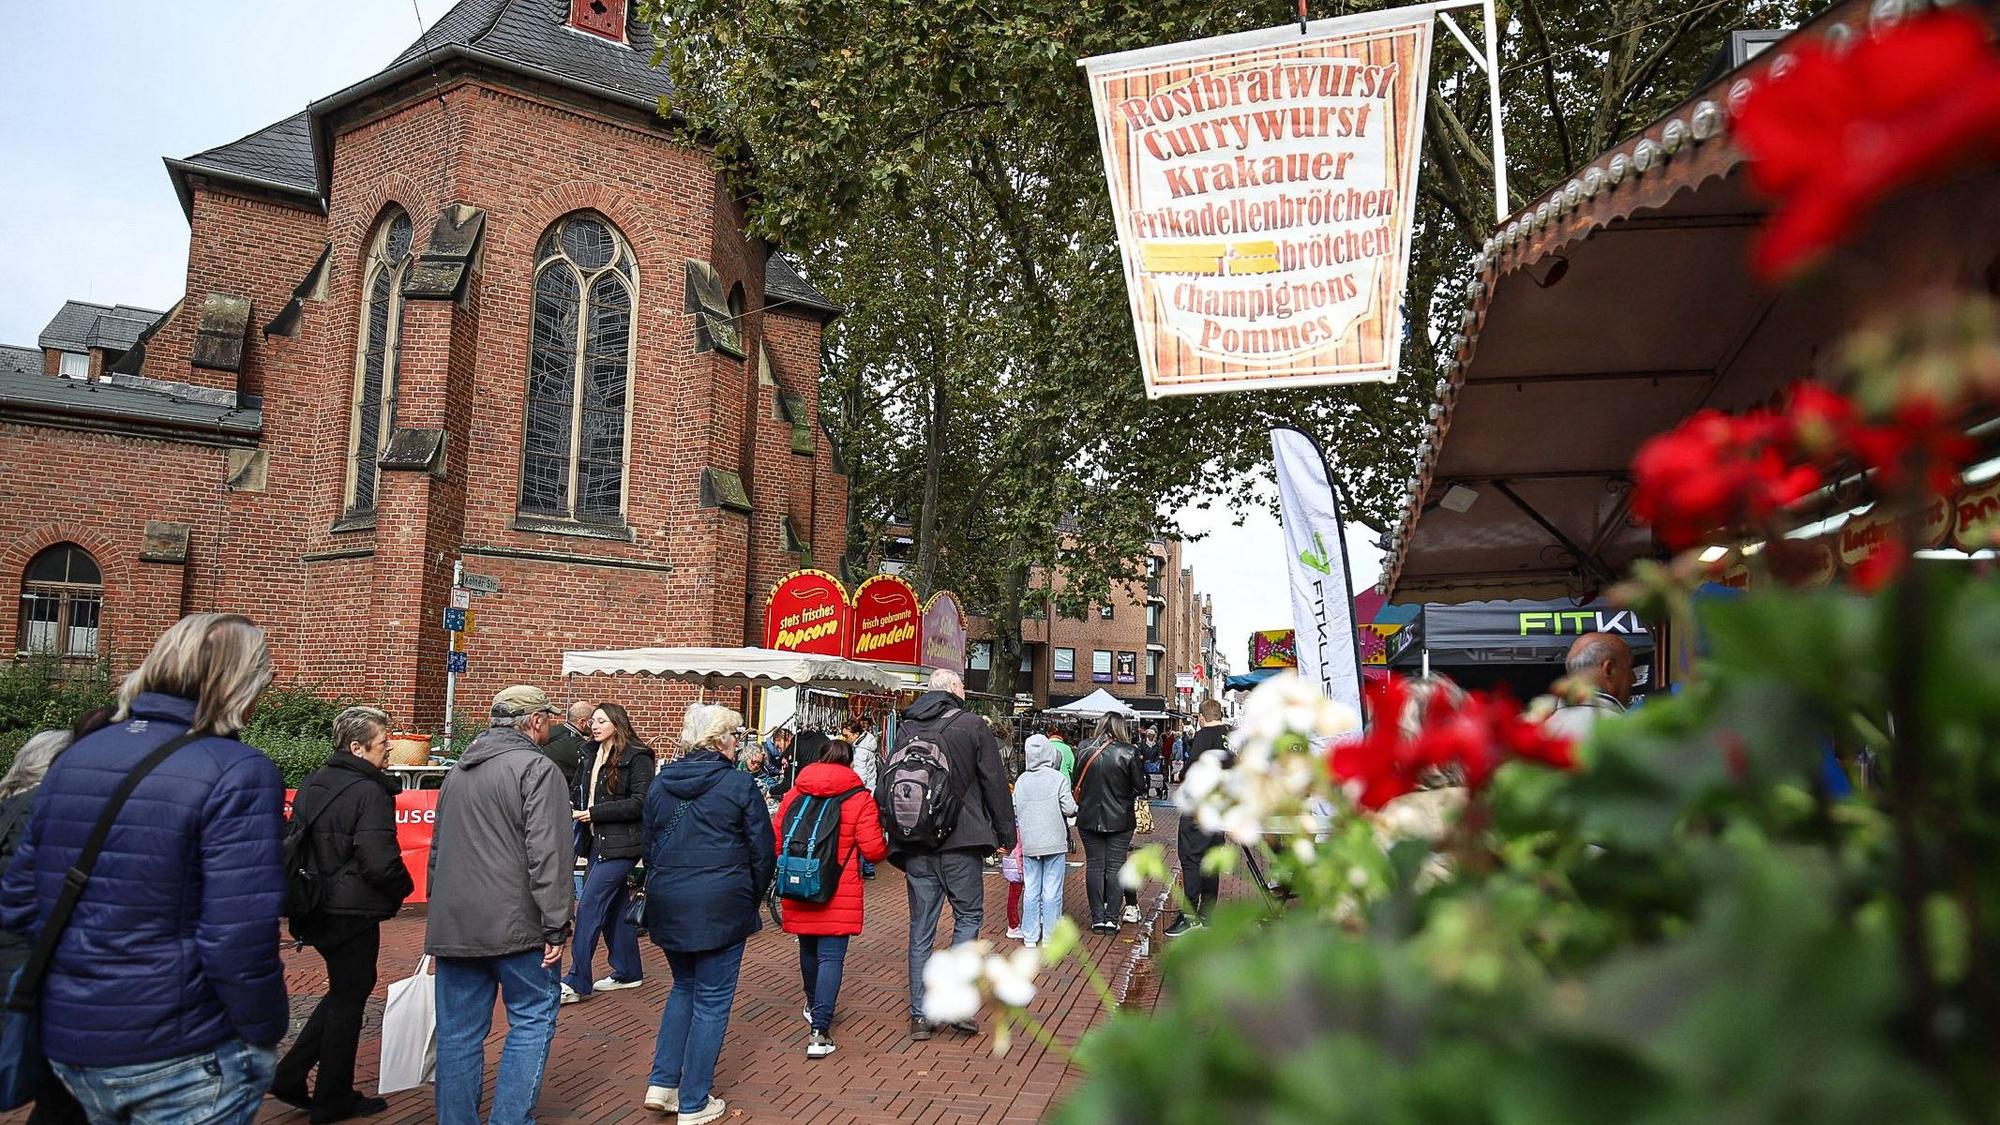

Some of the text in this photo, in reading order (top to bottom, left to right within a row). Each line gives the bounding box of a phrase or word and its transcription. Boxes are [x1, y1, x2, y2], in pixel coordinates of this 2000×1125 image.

[1119, 62, 1396, 132] Rostbratwurst
[1143, 102, 1372, 161] Currywurst
[1162, 150, 1354, 199] Krakauer
[1133, 187, 1393, 239] Frikadellenbrötchen
[1174, 271, 1358, 322] Champignons
[1200, 313, 1333, 354] Pommes
[774, 619, 838, 651] Popcorn
[779, 603, 835, 630] stets frisches
[855, 621, 915, 654] Mandeln
[862, 609, 912, 630] frisch gebrannte
